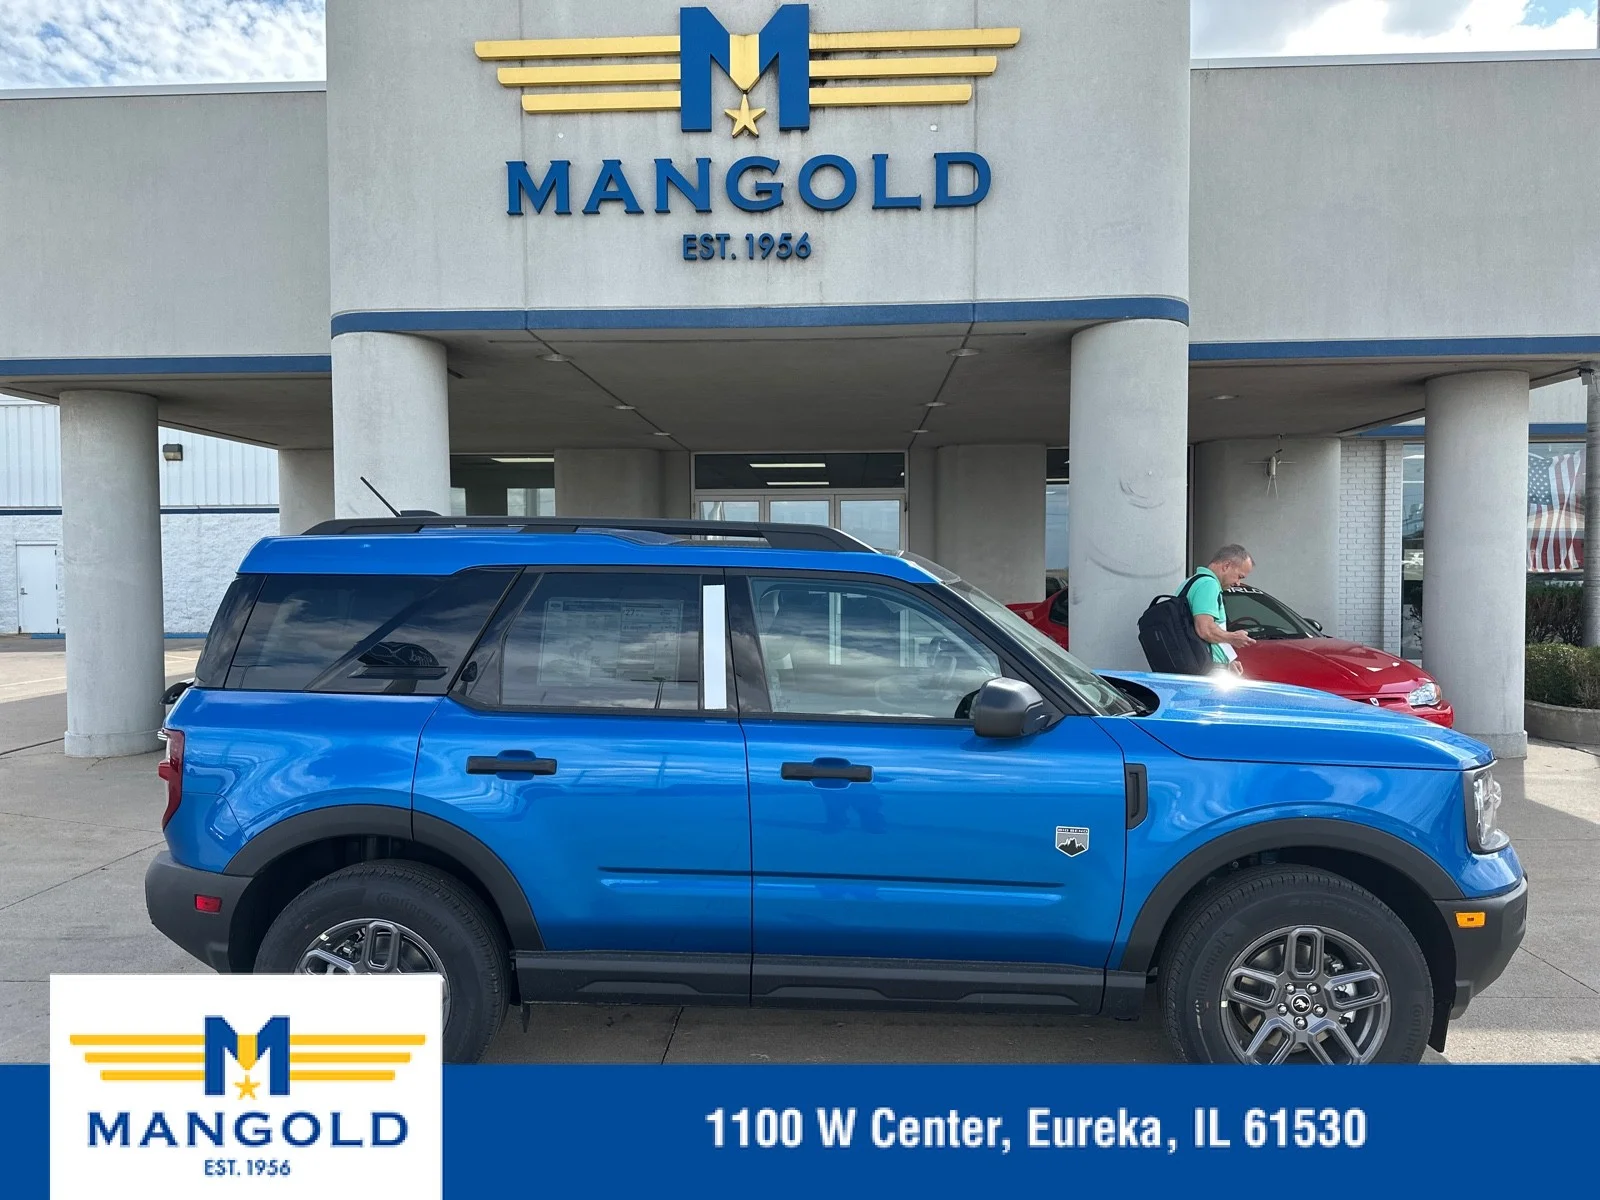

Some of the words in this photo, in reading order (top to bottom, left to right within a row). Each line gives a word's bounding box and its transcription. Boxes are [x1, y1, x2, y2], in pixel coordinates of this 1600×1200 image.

[679, 4, 810, 132] M
[505, 152, 992, 216] MANGOLD
[682, 234, 737, 260] EST.
[745, 232, 812, 260] 1956
